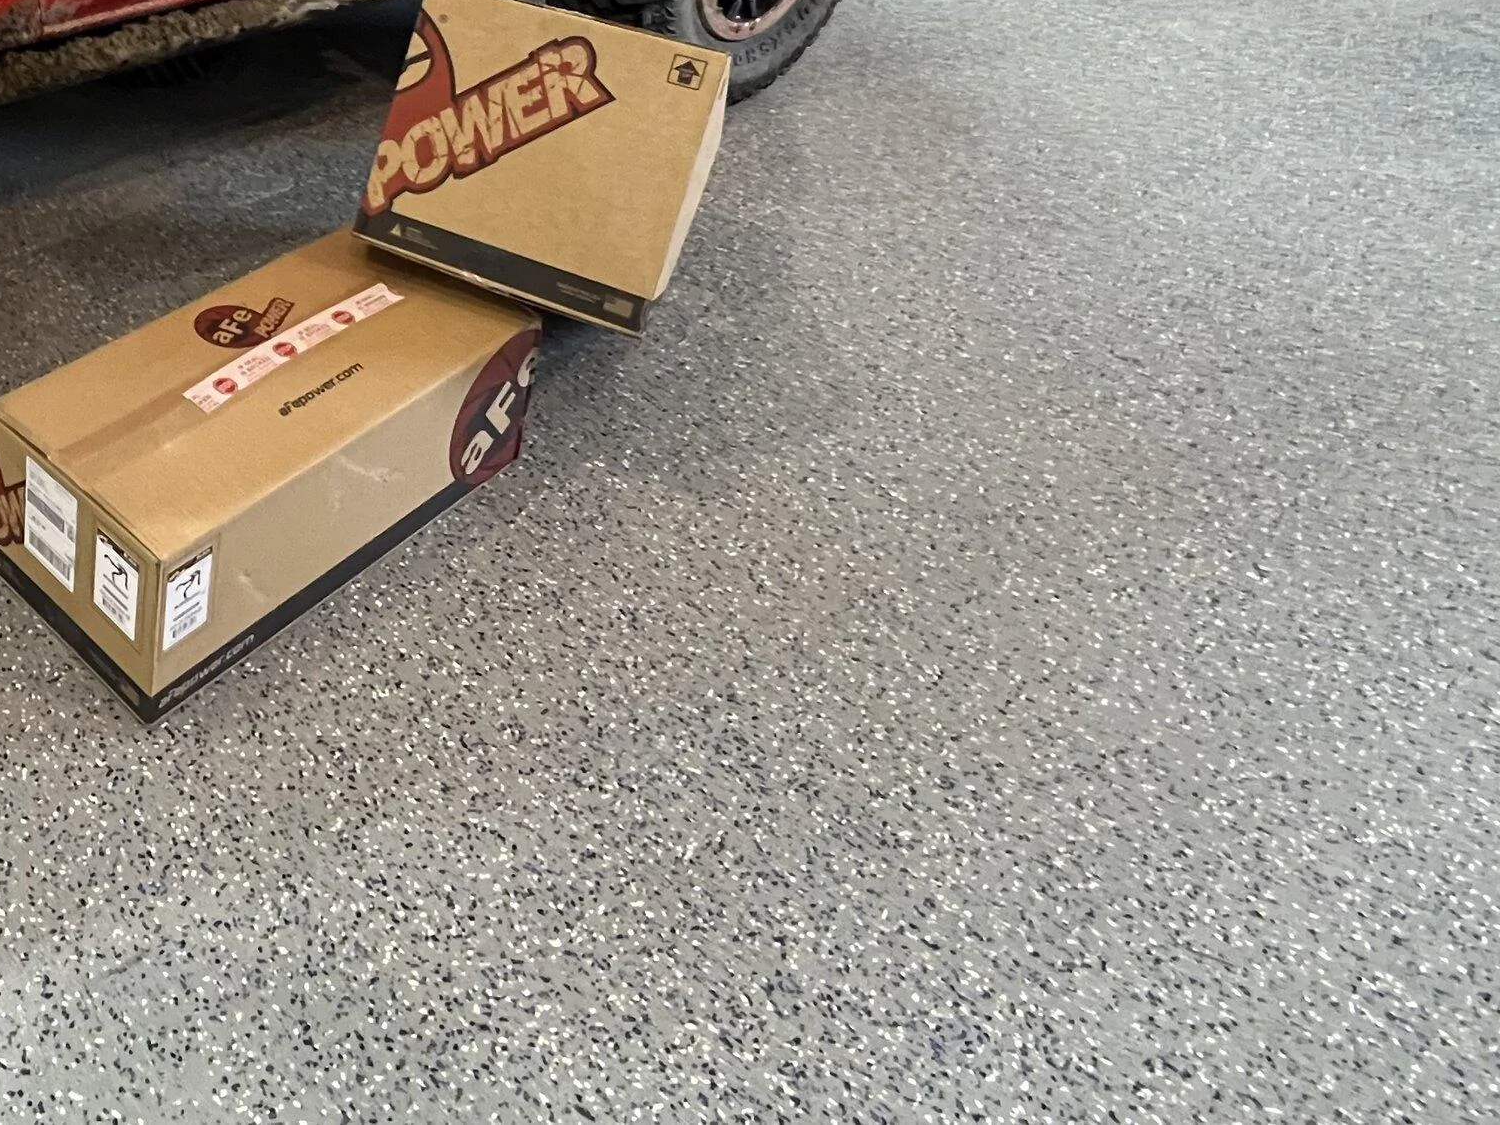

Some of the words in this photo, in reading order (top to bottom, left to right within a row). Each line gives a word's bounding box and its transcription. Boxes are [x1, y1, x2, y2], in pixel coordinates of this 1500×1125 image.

[366, 42, 600, 209] POWER
[212, 309, 252, 344] aFe
[461, 346, 541, 475] aFe
